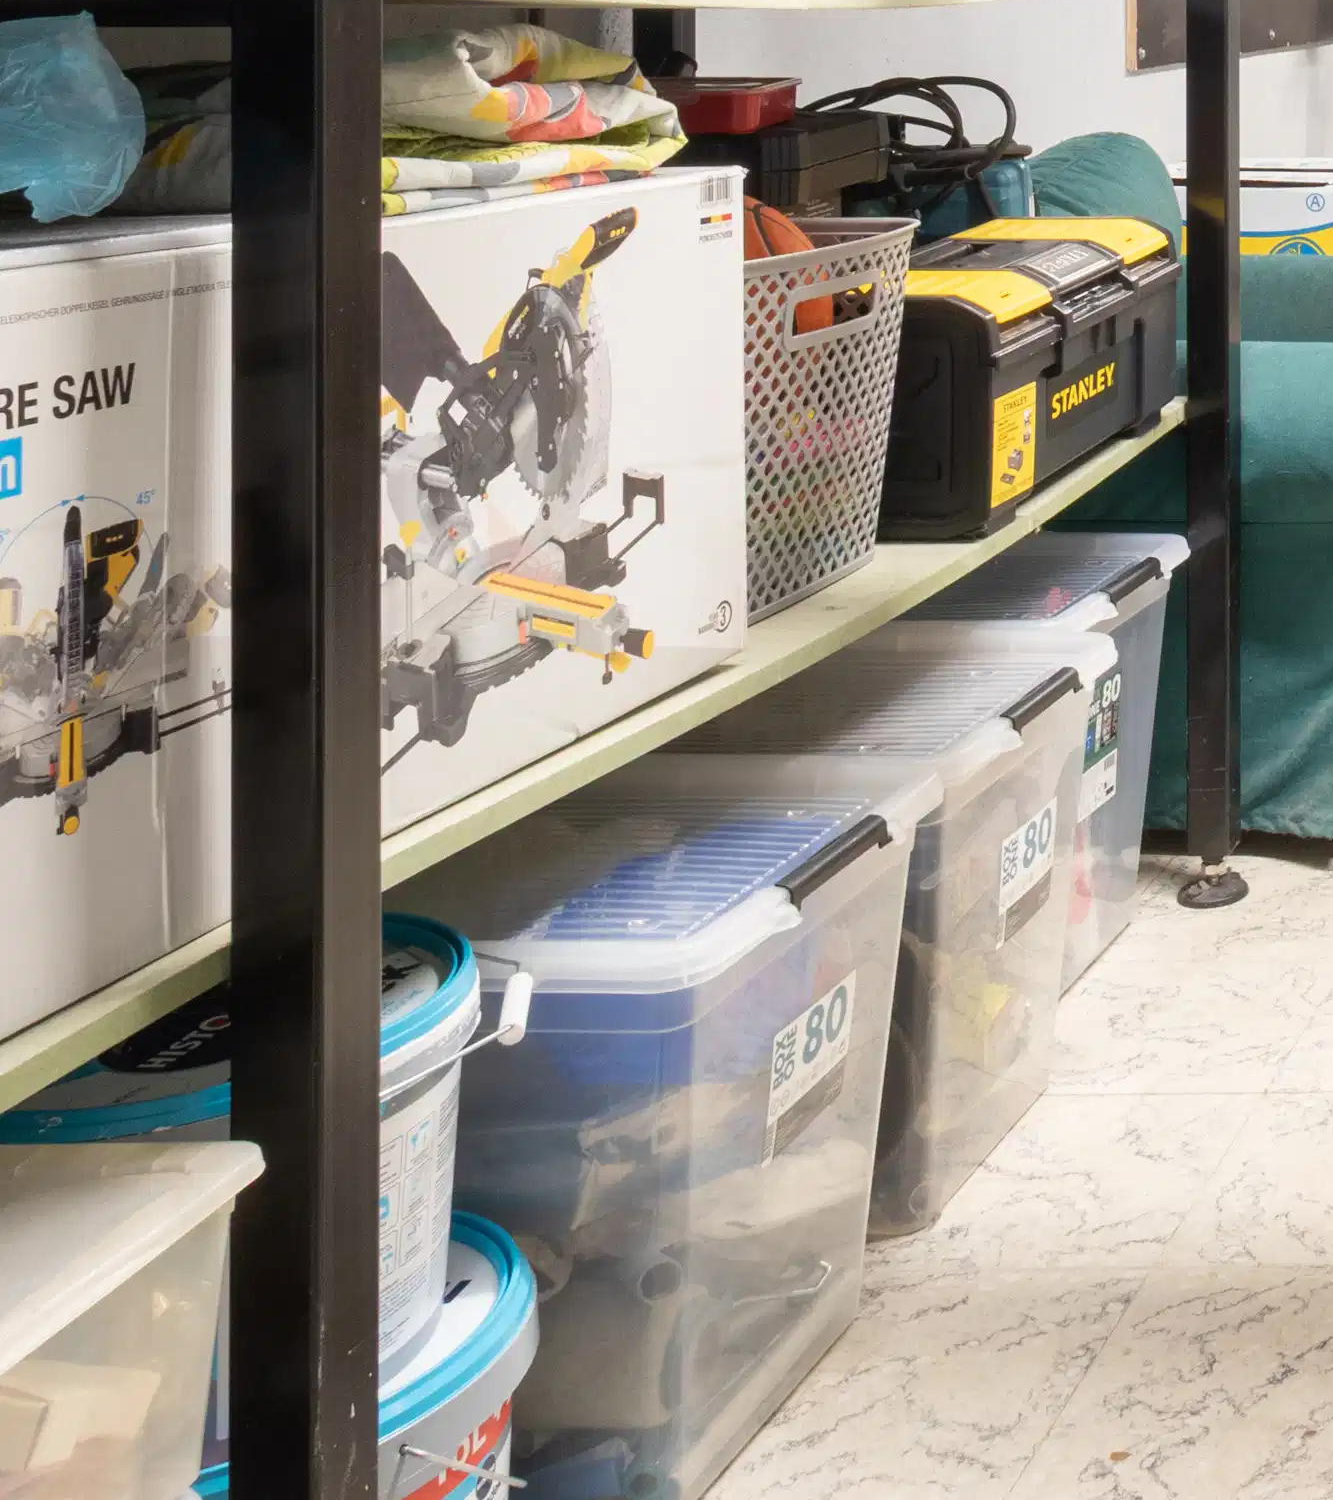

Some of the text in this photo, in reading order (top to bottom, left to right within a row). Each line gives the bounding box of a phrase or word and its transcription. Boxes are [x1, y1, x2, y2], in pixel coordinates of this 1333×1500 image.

[52, 362, 136, 420] SAW
[1003, 395, 1028, 413] STANLEY
[1051, 361, 1116, 420] STANLEY
[1102, 673, 1122, 709] 80
[1002, 842, 1012, 887] BOX
[1023, 807, 1053, 869] 80
[136, 1013, 232, 1069] HISTO
[783, 1022, 798, 1082] ONE
[802, 985, 848, 1065] 80
[773, 1036, 788, 1091] BOX
